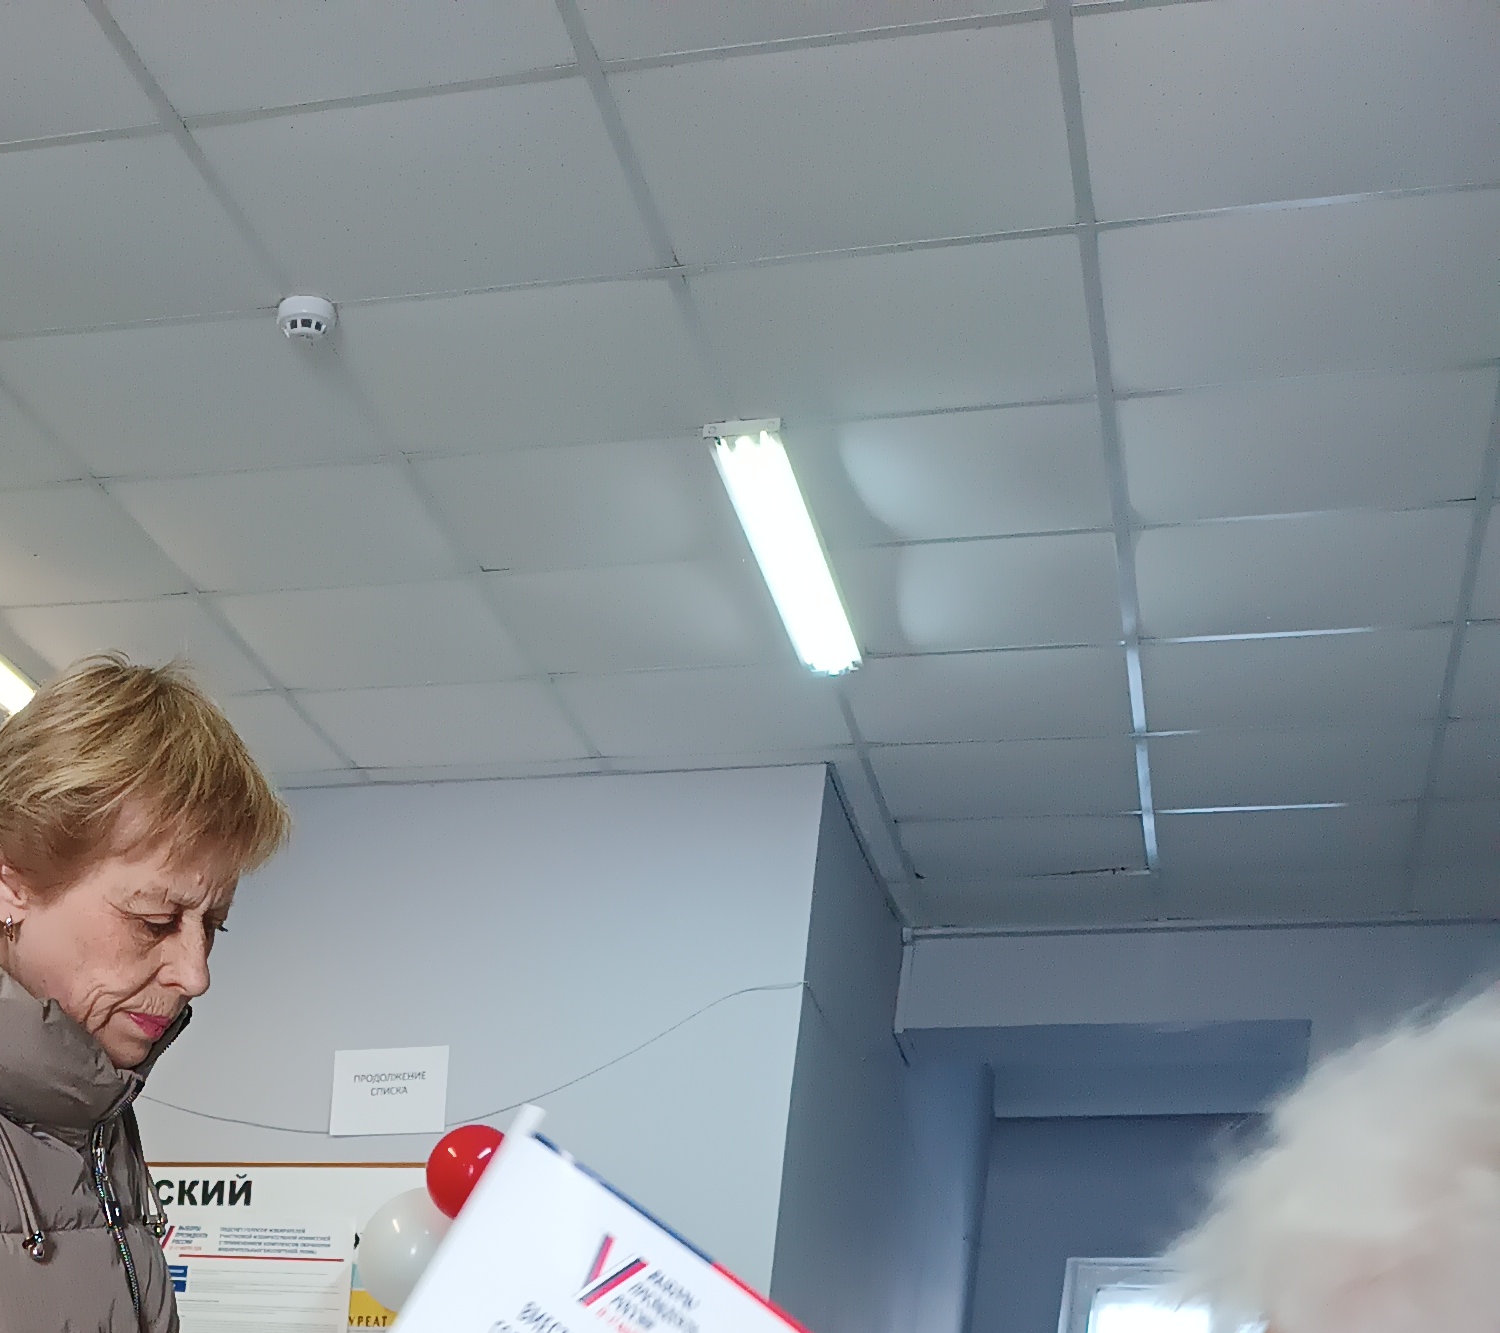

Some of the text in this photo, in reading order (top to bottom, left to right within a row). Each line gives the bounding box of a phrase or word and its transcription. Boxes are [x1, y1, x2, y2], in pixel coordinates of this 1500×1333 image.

[353, 1071, 427, 1084] ПРОДОЛЖЕНИЕ
[370, 1086, 408, 1097] СПИСКА
[156, 1174, 253, 1207] СКИЙ
